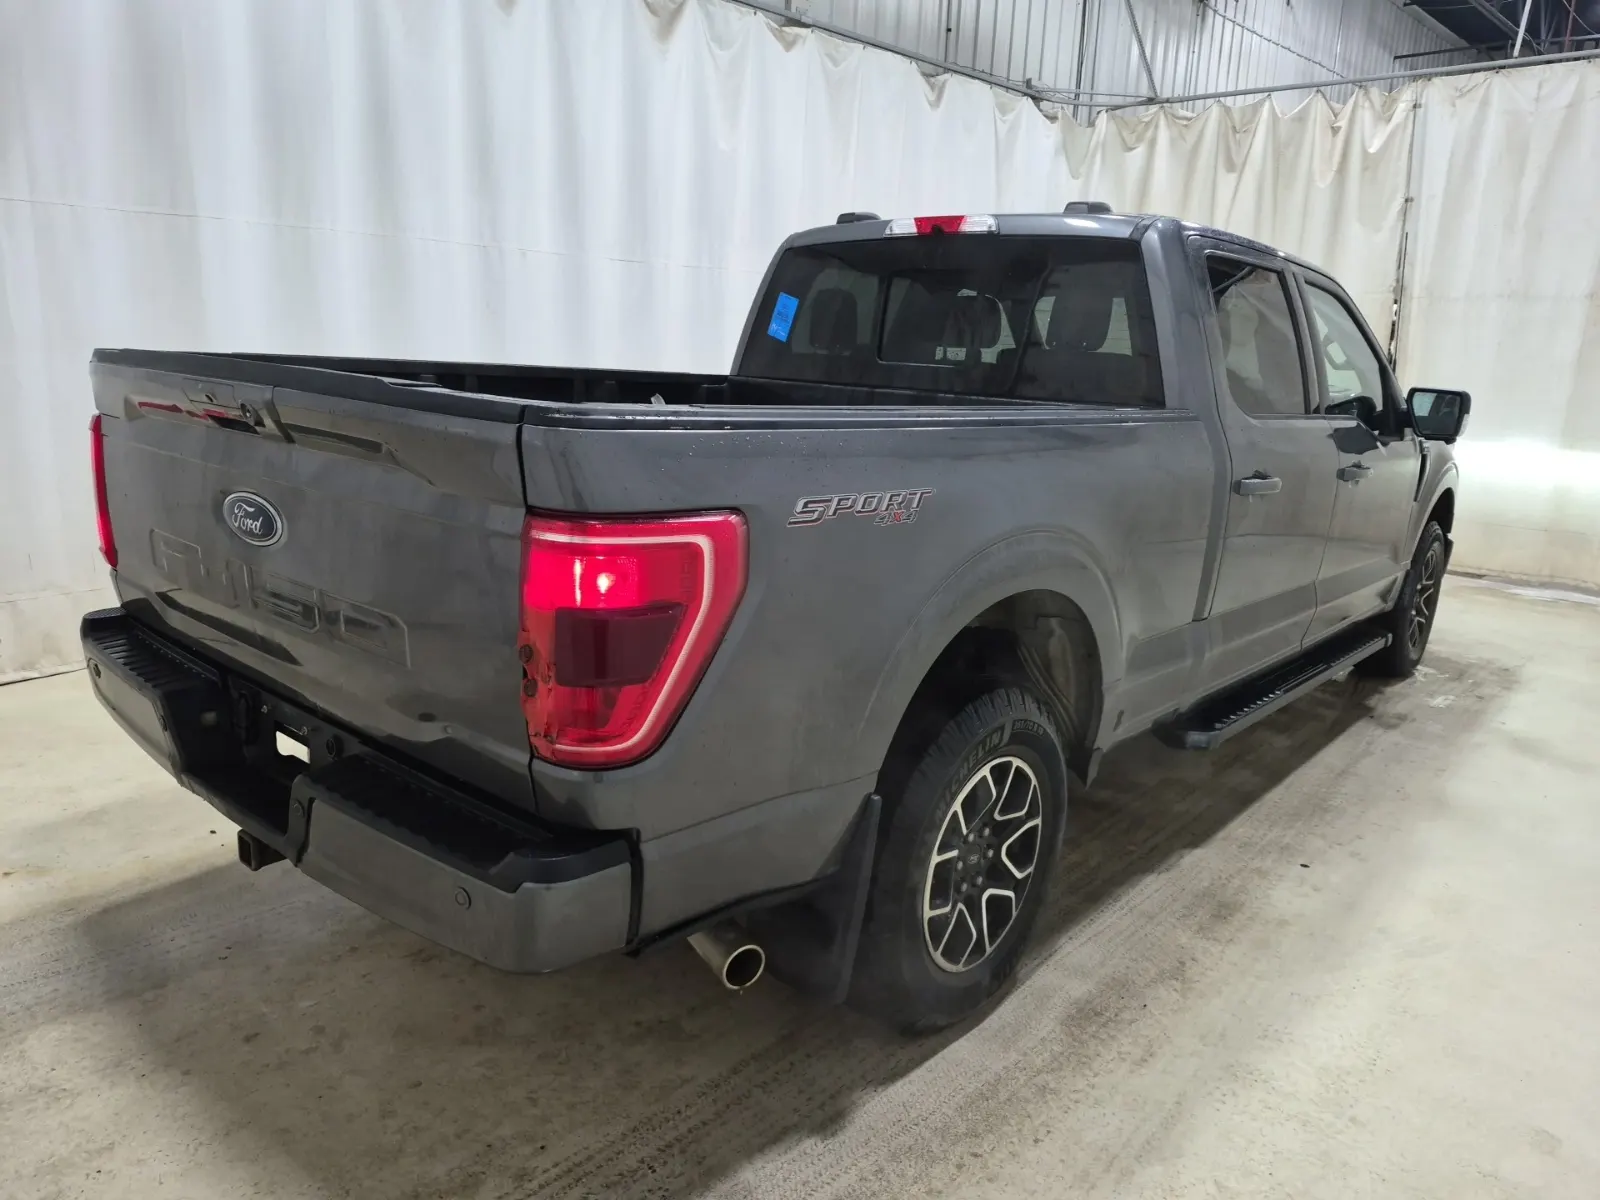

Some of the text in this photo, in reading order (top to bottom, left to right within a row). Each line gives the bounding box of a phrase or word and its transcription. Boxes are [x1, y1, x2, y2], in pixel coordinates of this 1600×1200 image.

[232, 502, 263, 535] Ford
[787, 488, 933, 527] SPORT
[933, 728, 1003, 823] MICHELIN
